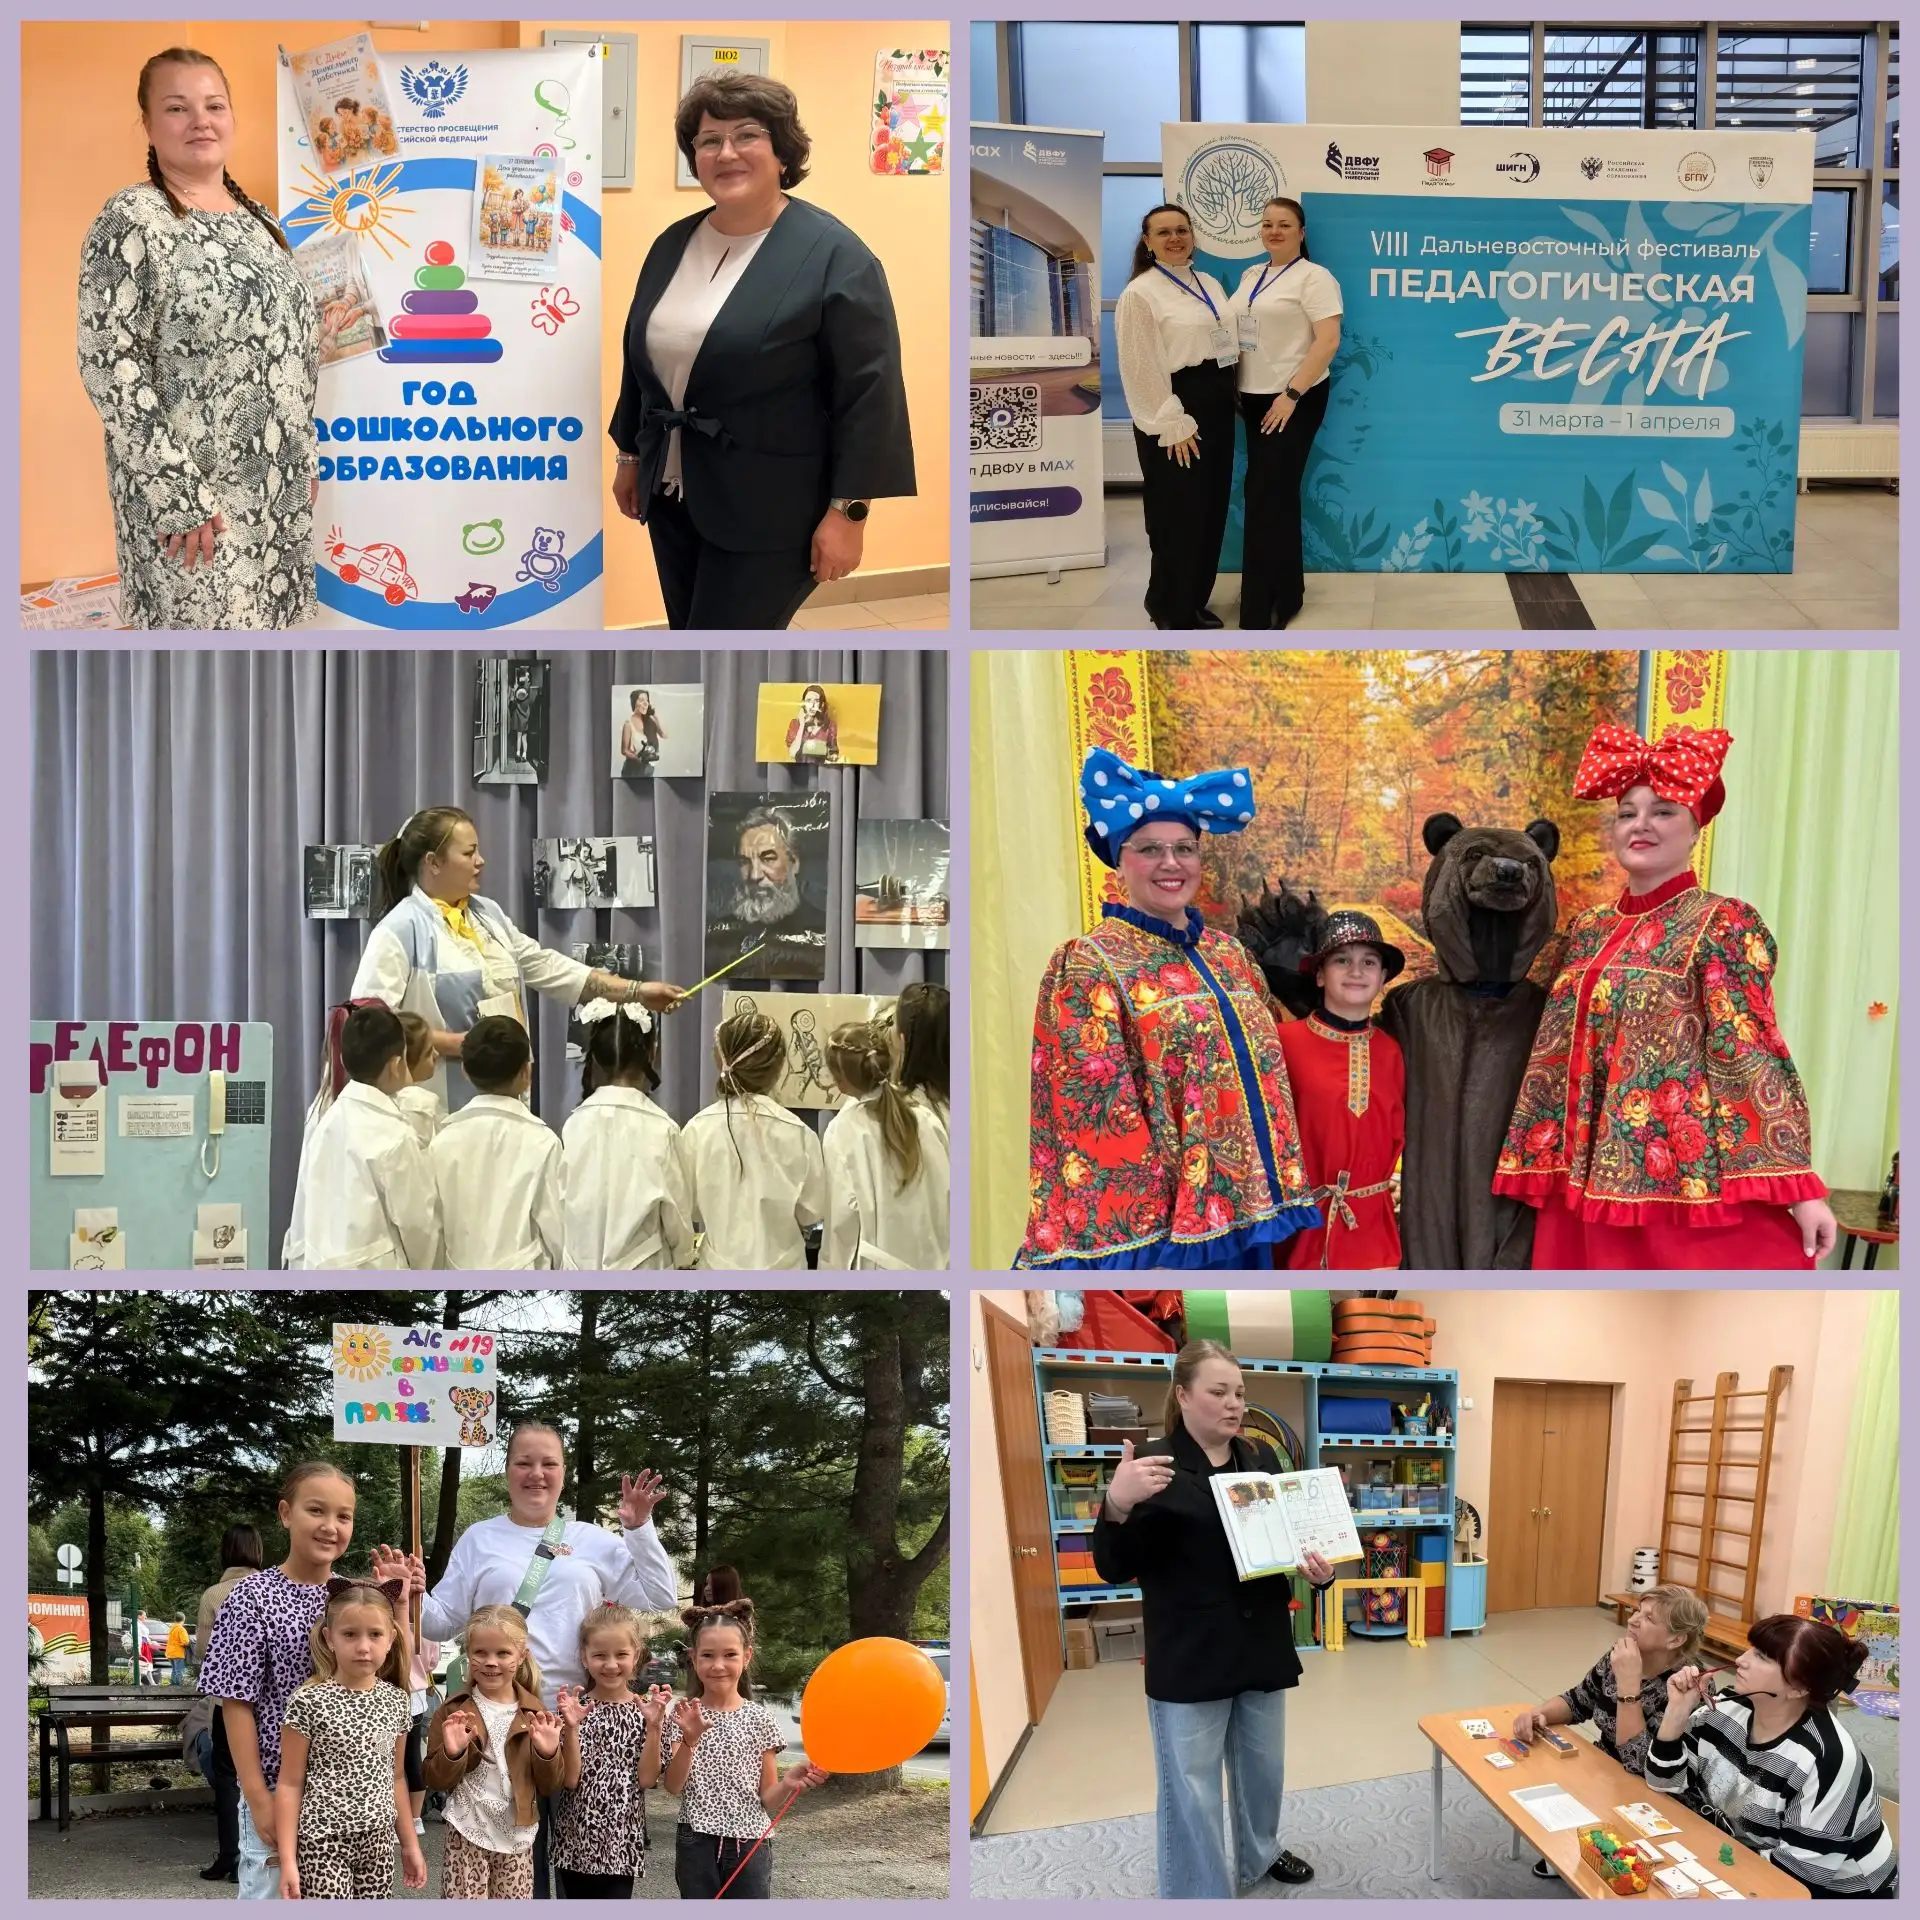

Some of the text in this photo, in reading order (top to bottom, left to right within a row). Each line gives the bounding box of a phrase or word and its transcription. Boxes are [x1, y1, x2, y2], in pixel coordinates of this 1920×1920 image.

[714, 50, 738, 60] ЩО2
[437, 124, 499, 133] ПРОСВЕЩЕНИЯ
[438, 135, 488, 144] ФЕДЕРАЦИИ
[1345, 156, 1380, 166] ДВФУ
[1496, 164, 1527, 172] ШИГН
[1684, 173, 1708, 182] БГПУ
[1370, 230, 1761, 261] VIII Дальневосточный фестиваль
[1370, 268, 1755, 304] ПЕДАГОГИЧЕСКАЯ
[1454, 312, 1752, 400] ВЕСНА
[402, 381, 477, 405] ГОД
[1512, 410, 1531, 427] 31
[1539, 413, 1604, 431] марта
[1627, 412, 1634, 429] 1
[1640, 416, 1720, 434] апреля
[318, 455, 568, 481] ОБРАЗОВАНИЯ
[980, 463, 1025, 478] ДВФУ
[1028, 464, 1036, 472] в
